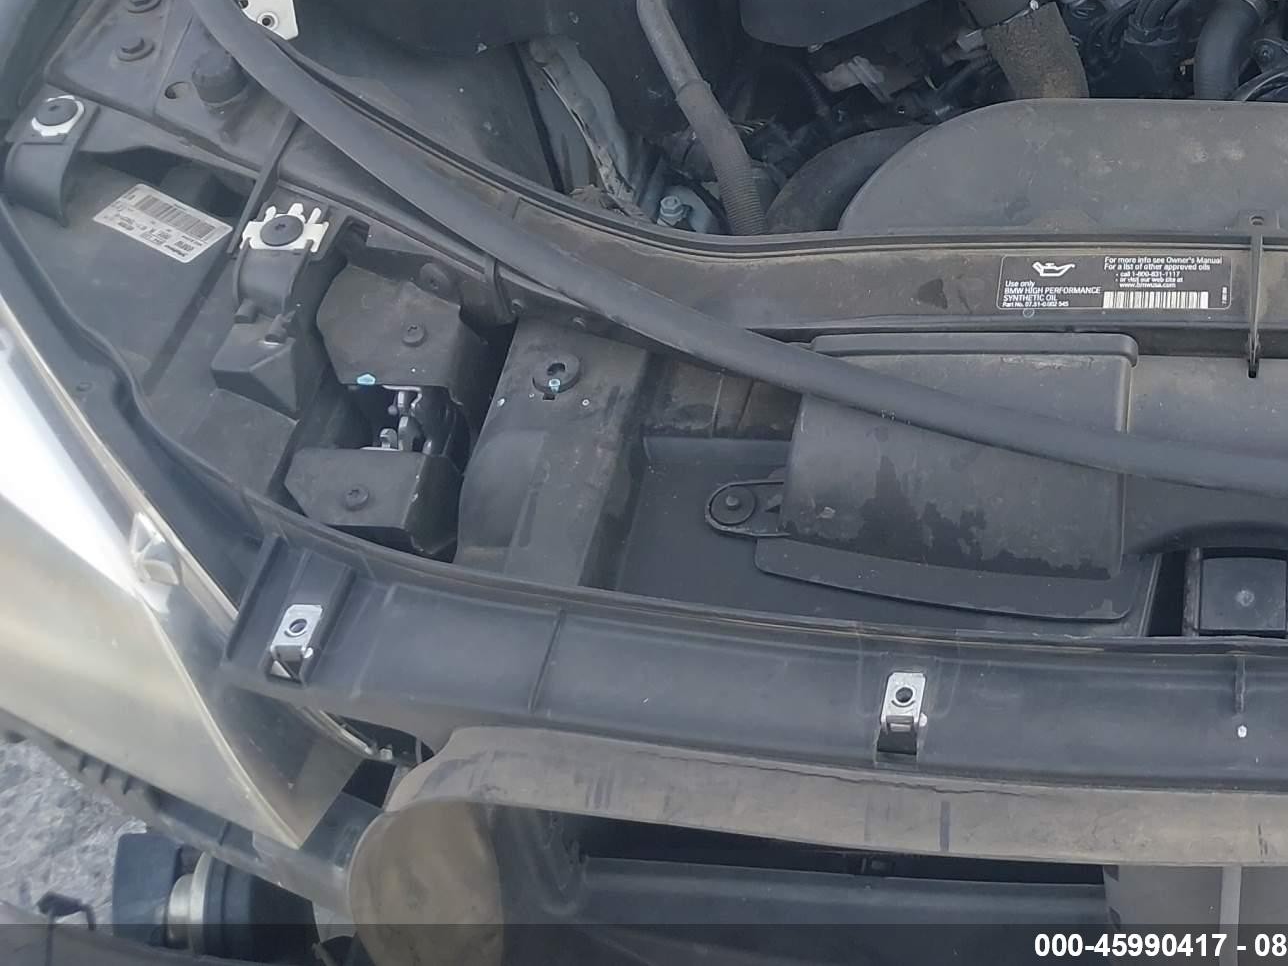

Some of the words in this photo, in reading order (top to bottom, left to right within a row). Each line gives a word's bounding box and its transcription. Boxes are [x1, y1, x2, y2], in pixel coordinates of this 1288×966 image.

[1104, 256, 1117, 264] For
[1137, 256, 1152, 264] info
[1166, 256, 1195, 264] Owner's
[1196, 256, 1222, 264] Manual
[1163, 263, 1197, 271] approved
[1020, 280, 1036, 288] only
[1045, 286, 1101, 294] PERFORMANCE
[1003, 294, 1045, 302] SYNTHETIC
